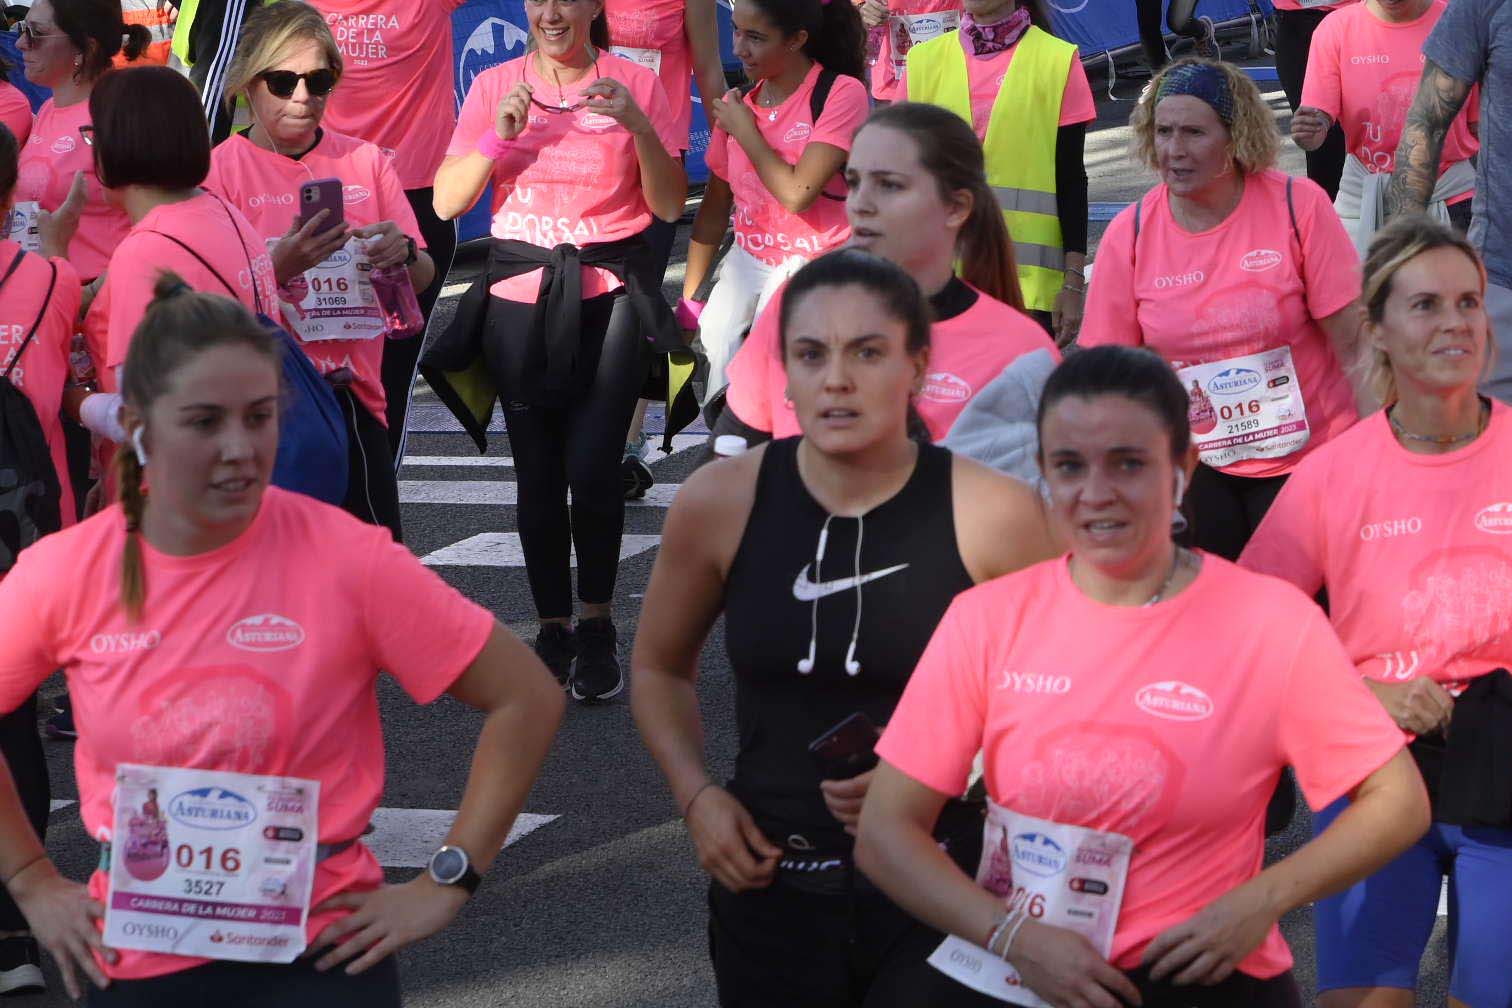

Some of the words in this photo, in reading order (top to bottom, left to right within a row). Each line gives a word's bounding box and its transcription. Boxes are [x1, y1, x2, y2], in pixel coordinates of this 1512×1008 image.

[326, 13, 400, 30] CARRERA
[337, 27, 358, 43] DE
[364, 30, 384, 44] LA
[1351, 55, 1390, 65] OYSHO
[1362, 121, 1383, 143] TU
[312, 276, 348, 293] 016
[1155, 270, 1204, 289] OYSHO
[1212, 376, 1258, 391] ASTURIANA
[1220, 400, 1260, 420] 016
[1227, 419, 1259, 434] 21589
[1254, 430, 1278, 441] MUJER
[1360, 517, 1422, 541] OYSHO
[90, 629, 161, 654] OYSHO
[230, 625, 301, 645] ASTURIANA
[1378, 651, 1419, 679] TU
[1140, 691, 1207, 715] ASTURIANA
[176, 801, 250, 822] ASTURIANA
[266, 799, 304, 814] SUMA
[176, 843, 241, 872] 016
[184, 879, 225, 896] 3527
[130, 897, 180, 912] CARRERA
[182, 903, 196, 914] DE
[198, 904, 214, 915] LA
[216, 906, 257, 918] MUJER
[260, 910, 286, 920] 2023
[122, 921, 179, 941] OYSHO
[225, 931, 290, 947] Santander
